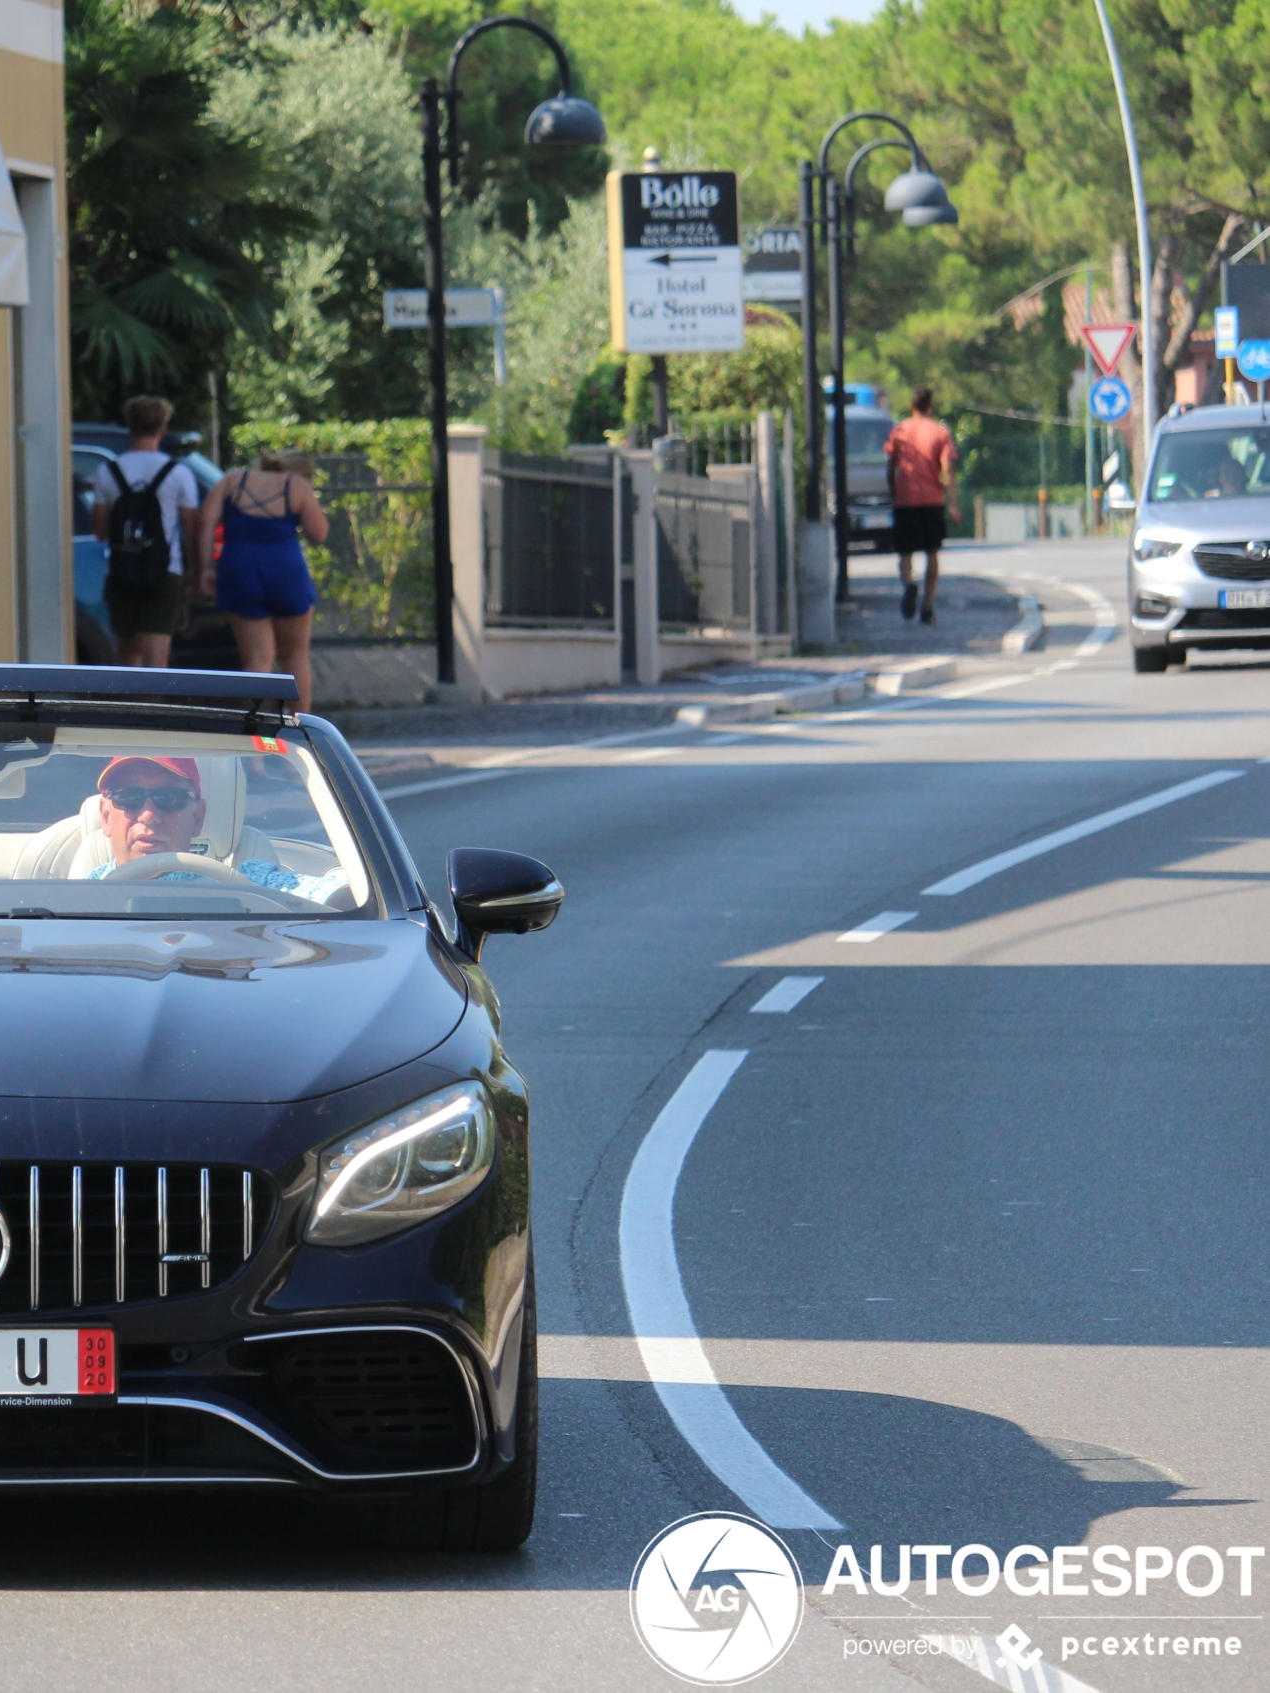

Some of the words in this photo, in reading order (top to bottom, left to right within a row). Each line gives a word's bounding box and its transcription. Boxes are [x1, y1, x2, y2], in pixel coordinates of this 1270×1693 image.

[675, 222, 716, 235] PIZZA
[640, 233, 720, 247] RISTORANTE
[657, 276, 705, 294] Hotel
[85, 1338, 105, 1351] 30
[16, 1337, 48, 1387] U
[85, 1355, 105, 1368] 09
[85, 1372, 106, 1386] 20
